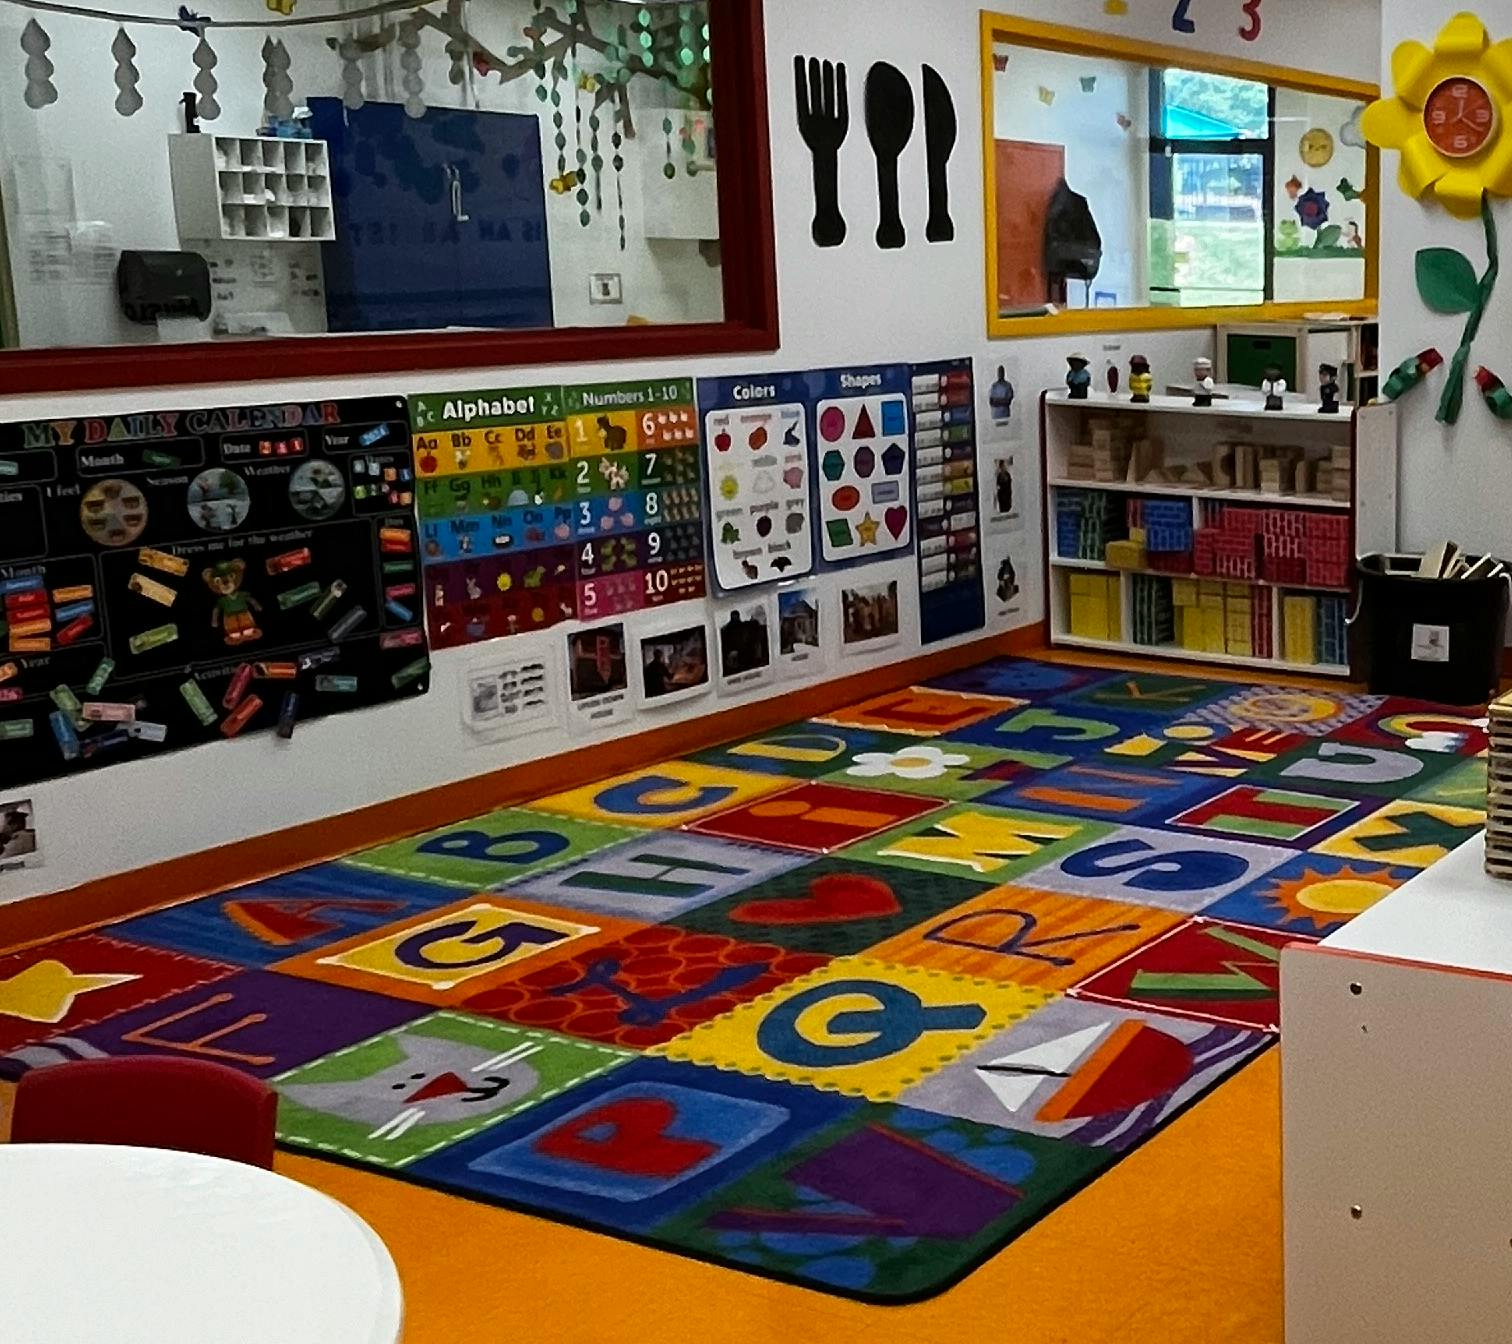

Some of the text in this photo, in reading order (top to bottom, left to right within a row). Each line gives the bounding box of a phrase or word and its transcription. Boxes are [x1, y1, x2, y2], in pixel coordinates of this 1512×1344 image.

[733, 384, 775, 401] Colors
[840, 373, 882, 388] Shapes
[442, 395, 535, 422] Alphabet
[583, 386, 678, 407] Numbers 1-10
[21, 402, 341, 448] MY DAILY CALENDAR
[451, 432, 472, 448] Bb
[484, 430, 503, 445] Cc
[514, 427, 536, 443] Dd
[575, 418, 588, 442] 1
[642, 415, 656, 435] 6
[576, 460, 590, 484] 2
[644, 453, 657, 475] 7
[580, 502, 592, 525] 3
[644, 493, 658, 515] 8
[581, 543, 594, 564] 4
[647, 531, 661, 555] 9
[584, 583, 597, 606] 5
[644, 569, 669, 594] 10
[861, 697, 992, 726] E
[996, 708, 1119, 742] J
[728, 735, 849, 762] D
[1281, 742, 1424, 783] U
[594, 775, 740, 823] C
[418, 830, 571, 864] B
[876, 812, 1086, 874] M
[560, 850, 742, 897] H
[1061, 838, 1252, 892] S
[220, 894, 406, 946] A
[396, 917, 584, 969] G
[922, 908, 1142, 967] R
[121, 991, 275, 1065] F
[756, 979, 987, 1069] Q
[535, 1097, 723, 1179] P
